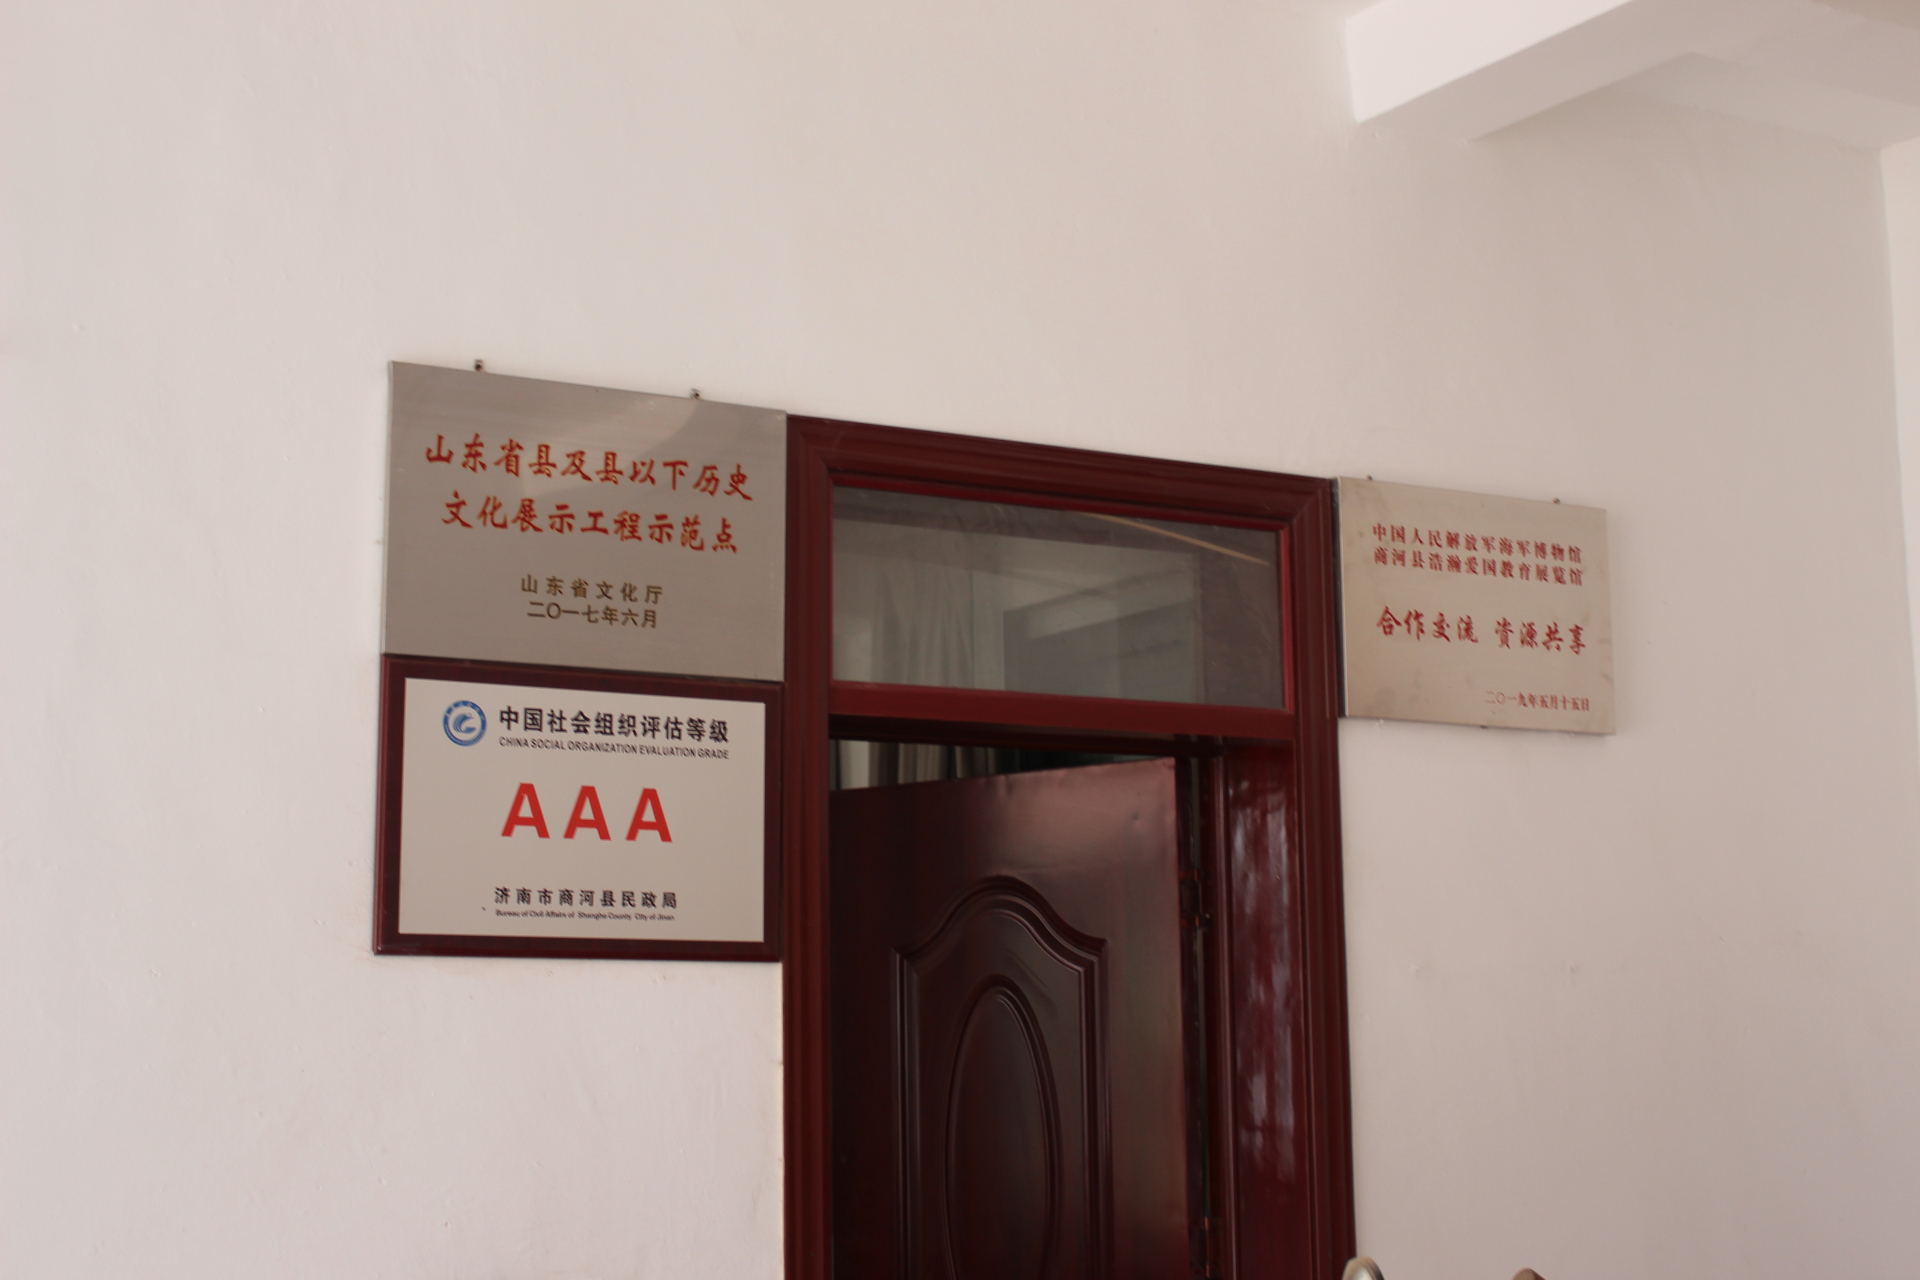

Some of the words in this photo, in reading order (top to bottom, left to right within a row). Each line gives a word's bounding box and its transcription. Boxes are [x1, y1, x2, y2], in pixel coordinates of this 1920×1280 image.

[425, 433, 754, 501] 山东省县及县以下历史
[441, 490, 738, 554] 文化展示工程示范点
[1372, 522, 1582, 564] 中国人民解放军海军博物馆
[1373, 546, 1583, 586] 商河县浩瀚爱国教育展览馆
[521, 574, 663, 604] 山东省文化厅
[1376, 605, 1479, 643] 合作交流
[1494, 617, 1586, 655] 资源共享
[499, 705, 730, 744] 中国社会组织评估等级
[499, 736, 529, 748] CHINA
[530, 738, 566, 750] SOCIAL
[567, 740, 638, 755] ORGANIZATION
[639, 744, 696, 758] EVALUATION
[697, 747, 730, 760] GRADE
[494, 886, 677, 909] 济南市商河县民政局
[495, 908, 520, 918] Bureau
[521, 910, 529, 918] of
[529, 910, 545, 918] Civil
[545, 910, 567, 919] Affairs
